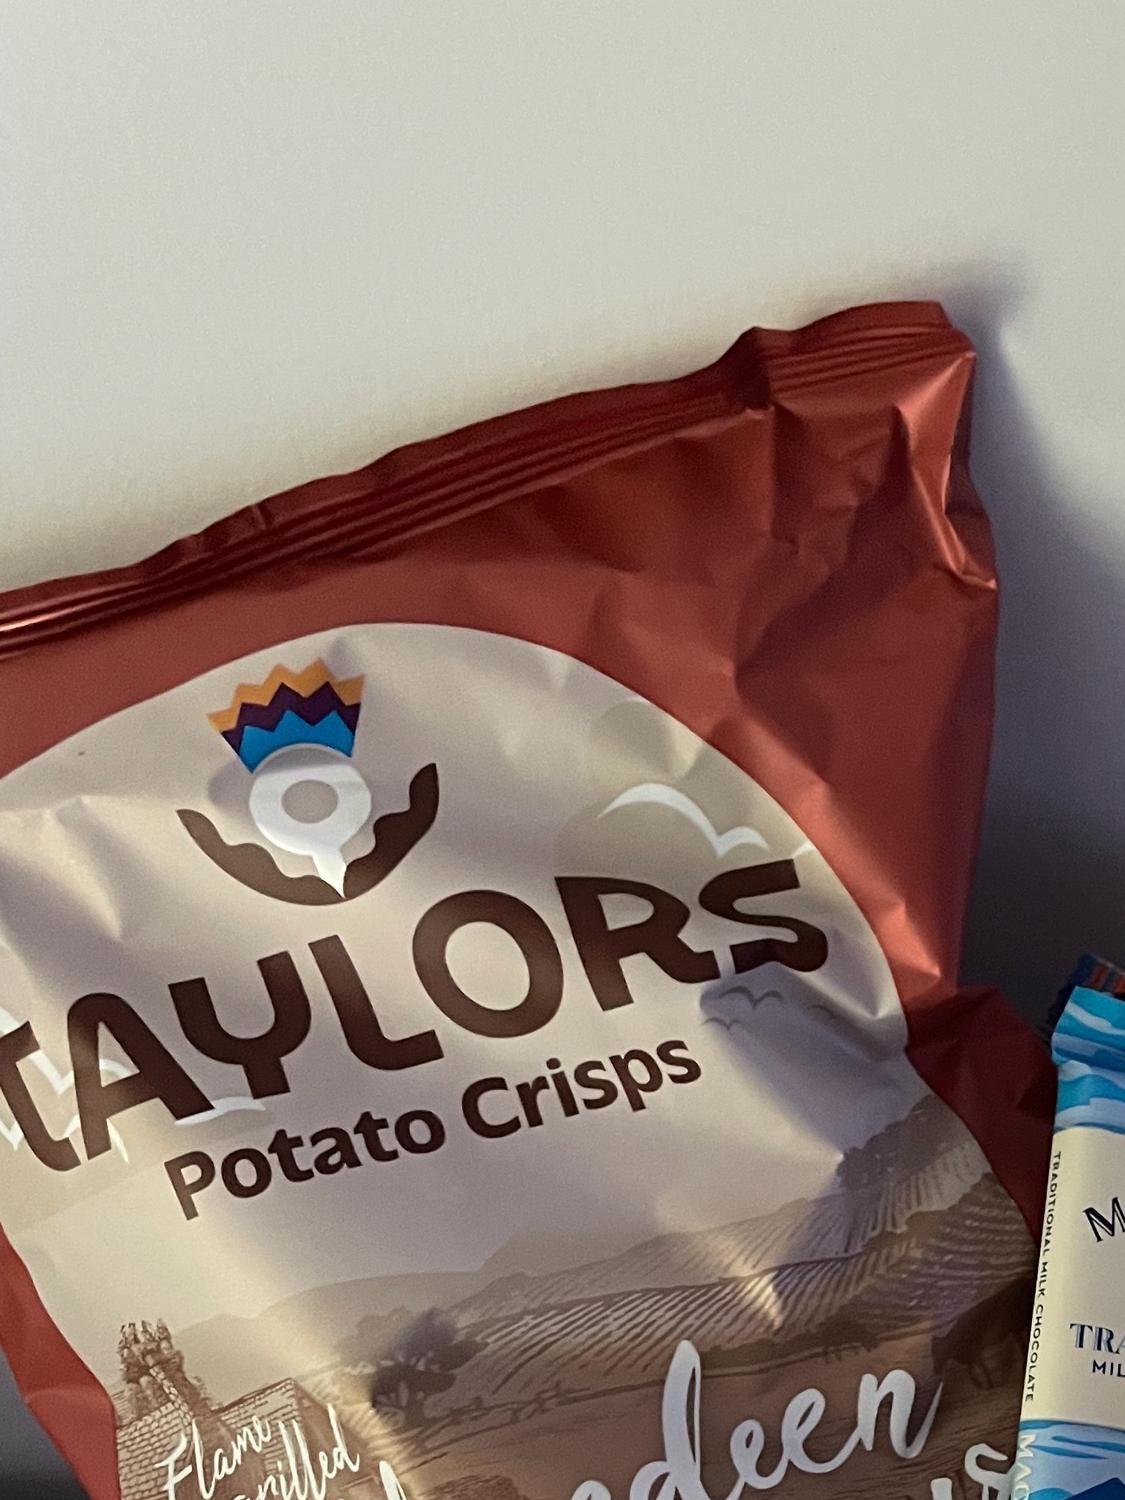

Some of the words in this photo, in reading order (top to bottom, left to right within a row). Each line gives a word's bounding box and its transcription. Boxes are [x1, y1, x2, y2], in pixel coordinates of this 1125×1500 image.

[0, 858, 829, 1173] TAYLORS
[163, 1107, 447, 1221] Potato
[461, 1039, 703, 1143] Crisps
[1041, 1150, 1062, 1258] TRADITIONAL
[1036, 1260, 1050, 1298] MILK
[1024, 1303, 1044, 1403] CHOCOLATE
